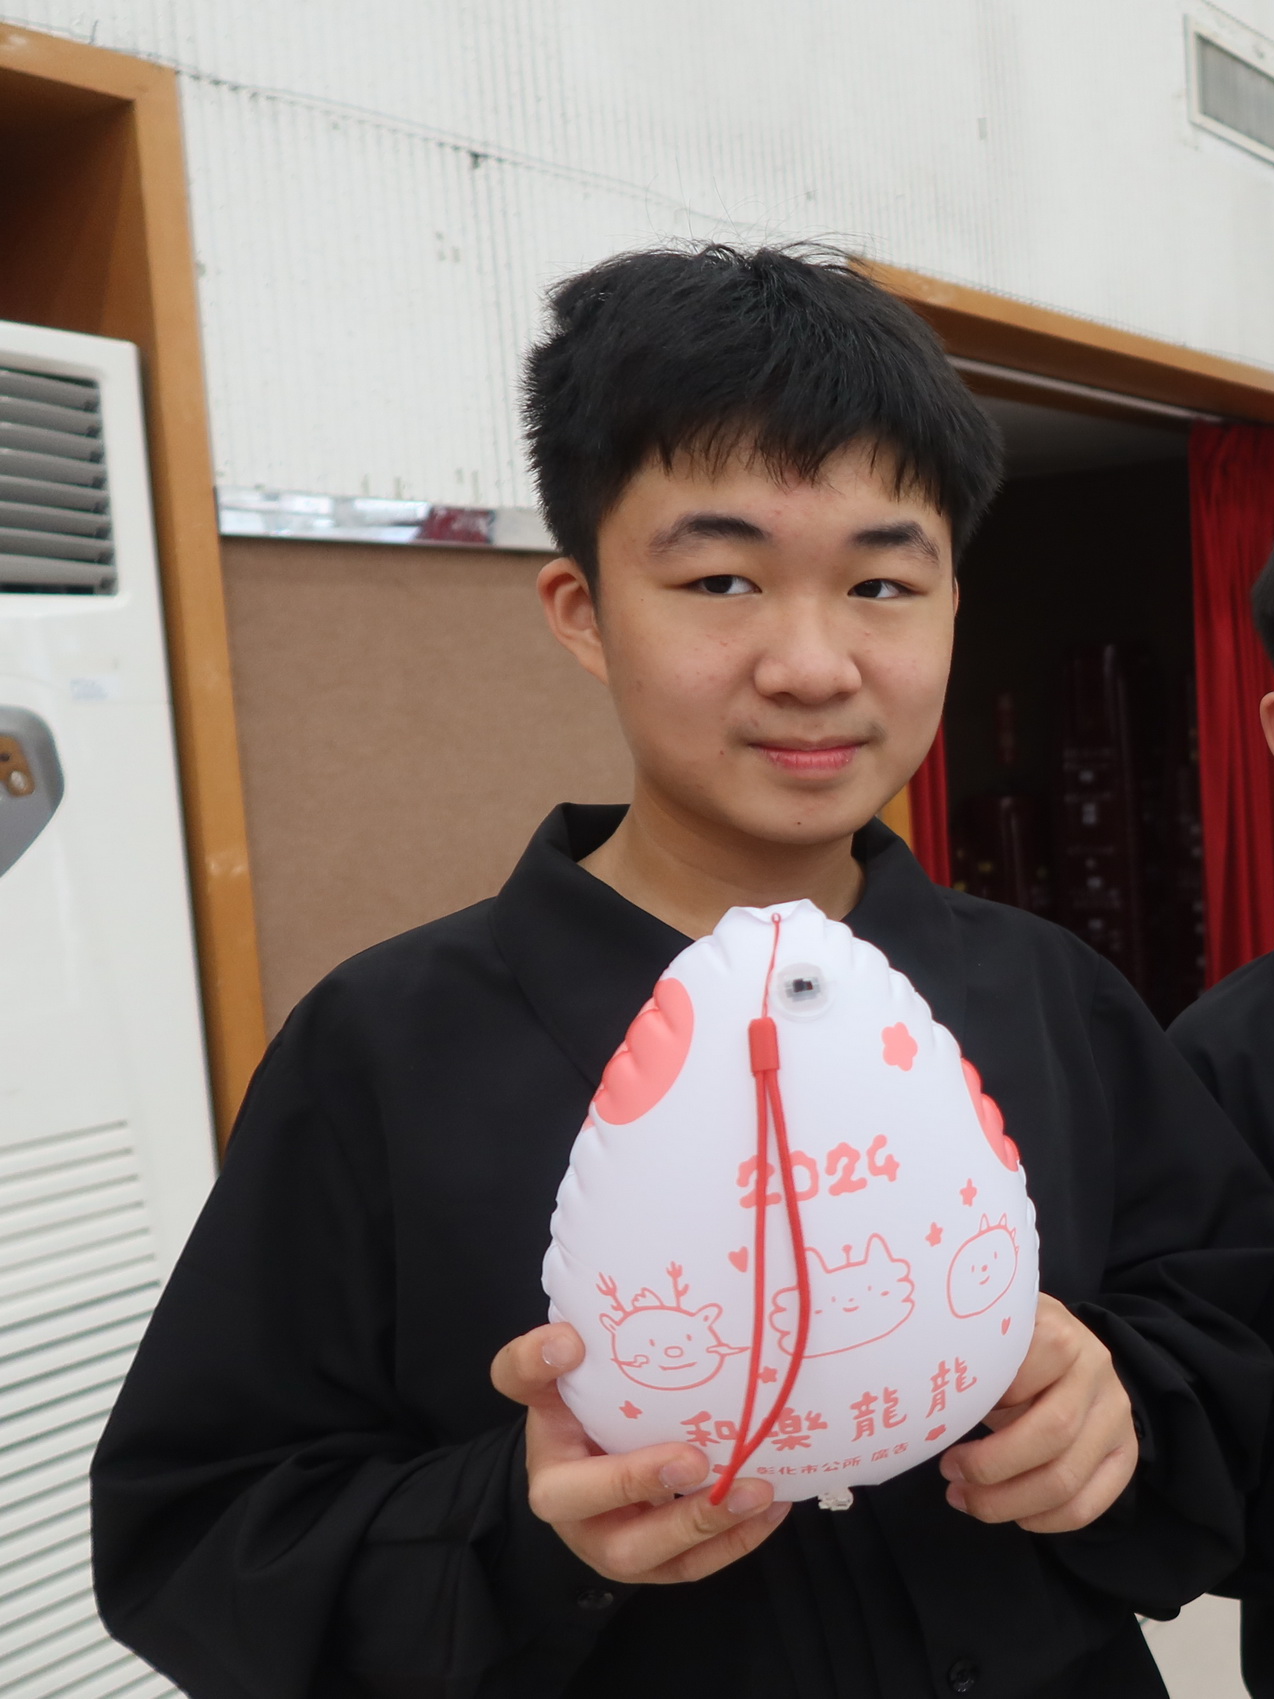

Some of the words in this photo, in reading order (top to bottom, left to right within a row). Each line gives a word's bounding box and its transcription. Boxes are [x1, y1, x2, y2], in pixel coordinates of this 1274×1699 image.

[736, 1134, 900, 1208] 2024
[680, 1357, 977, 1452] 和樂龍龍
[756, 1455, 862, 1475] 彰化市公所
[870, 1442, 909, 1462] 廣告
